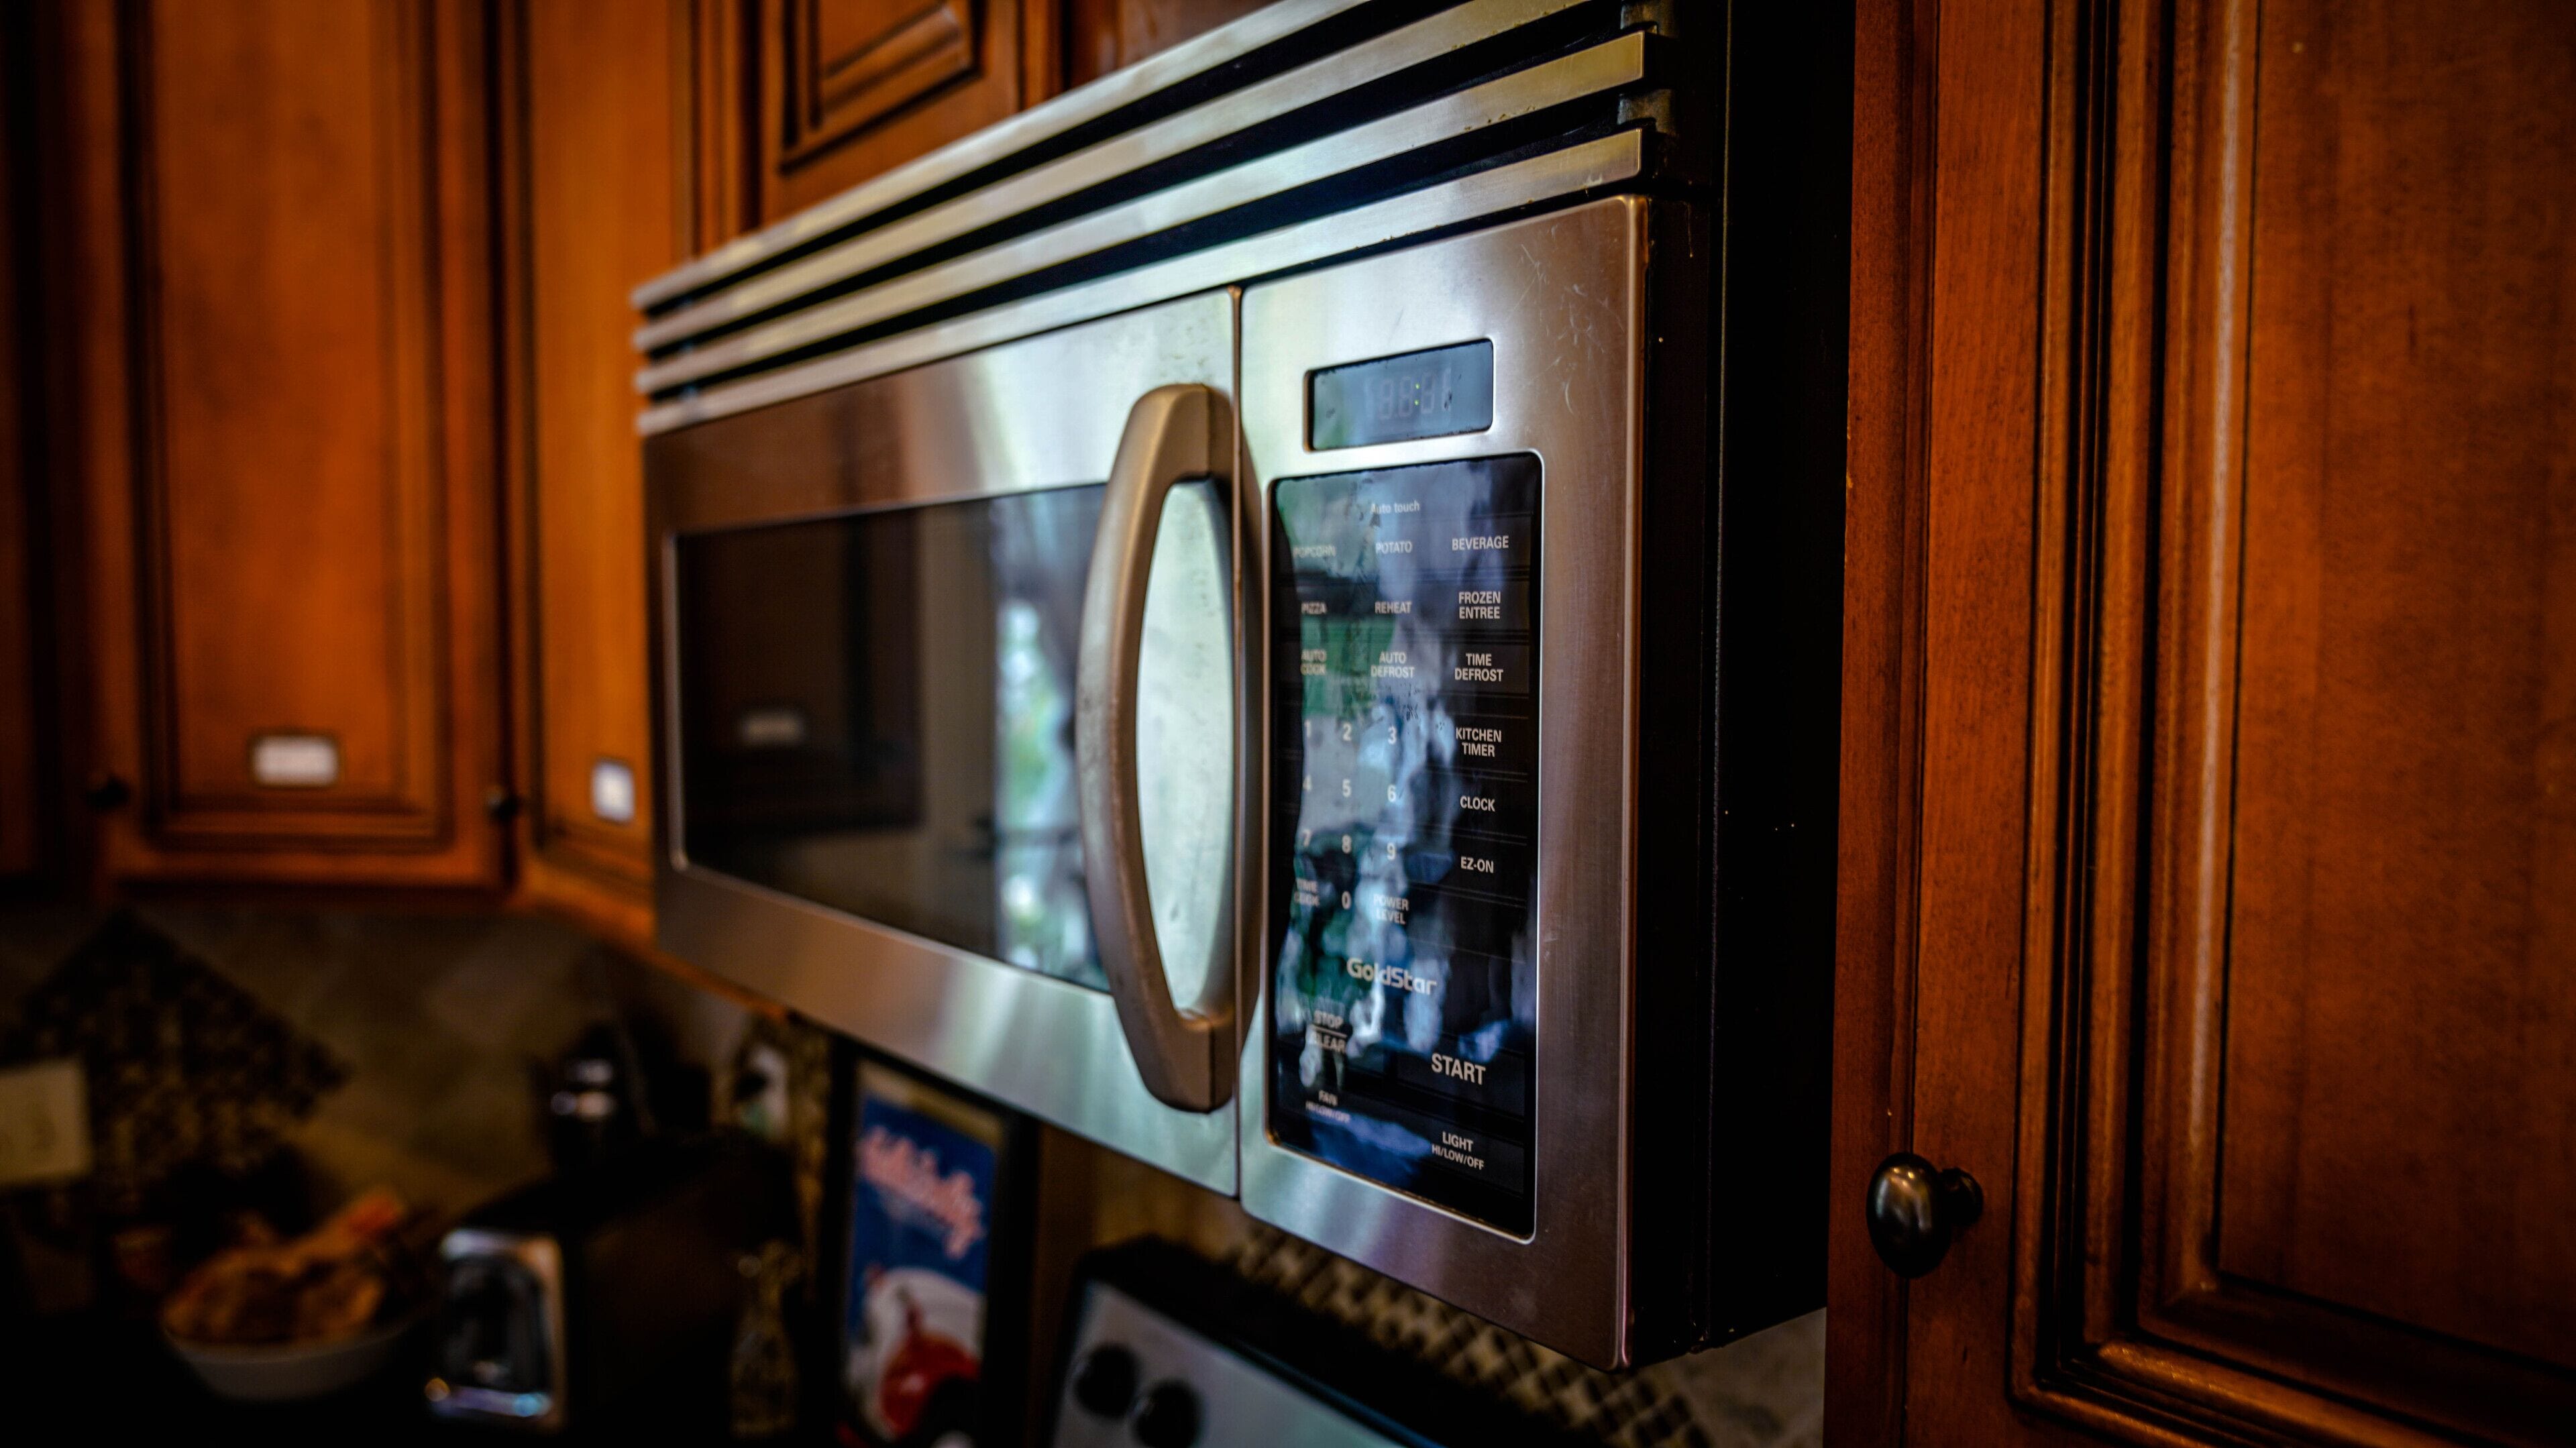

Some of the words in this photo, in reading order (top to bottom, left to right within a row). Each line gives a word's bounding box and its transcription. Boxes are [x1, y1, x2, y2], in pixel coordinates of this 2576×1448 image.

[1371, 502, 1392, 515] Auto
[1394, 500, 1420, 513] touch
[1375, 540, 1413, 555] POTATO
[1452, 535, 1509, 551] BEVERAGE
[1458, 591, 1501, 604] FROZEN
[1375, 601, 1412, 614] REHEAT
[1458, 606, 1501, 620] ENTREE
[1379, 651, 1407, 664] AUTO
[1465, 653, 1492, 667] TIME
[1371, 666, 1415, 679] DEFROST
[1454, 668, 1503, 682] DEFROST
[1343, 724, 1352, 741] 2
[1387, 726, 1397, 744] 3
[1455, 726, 1502, 743] KITCHEN
[1462, 742, 1495, 758] TIMER
[1342, 779, 1352, 797] 5
[1387, 783, 1397, 803] 6
[1460, 795, 1496, 812] CLOCK
[1302, 830, 1311, 846] 7
[1342, 834, 1352, 853] 8
[1386, 842, 1396, 860] 9
[1460, 856, 1494, 873] EZ-ON
[1342, 891, 1351, 909] 0
[1374, 893, 1409, 911] POWER
[1375, 909, 1407, 925] LEVEL
[1346, 957, 1438, 995] GoldStar
[1313, 1010, 1344, 1029] STOP
[1431, 1053, 1486, 1085] START
[1442, 1131, 1474, 1152] LIGHT
[1431, 1144, 1485, 1170] HI/LOW/OFF
